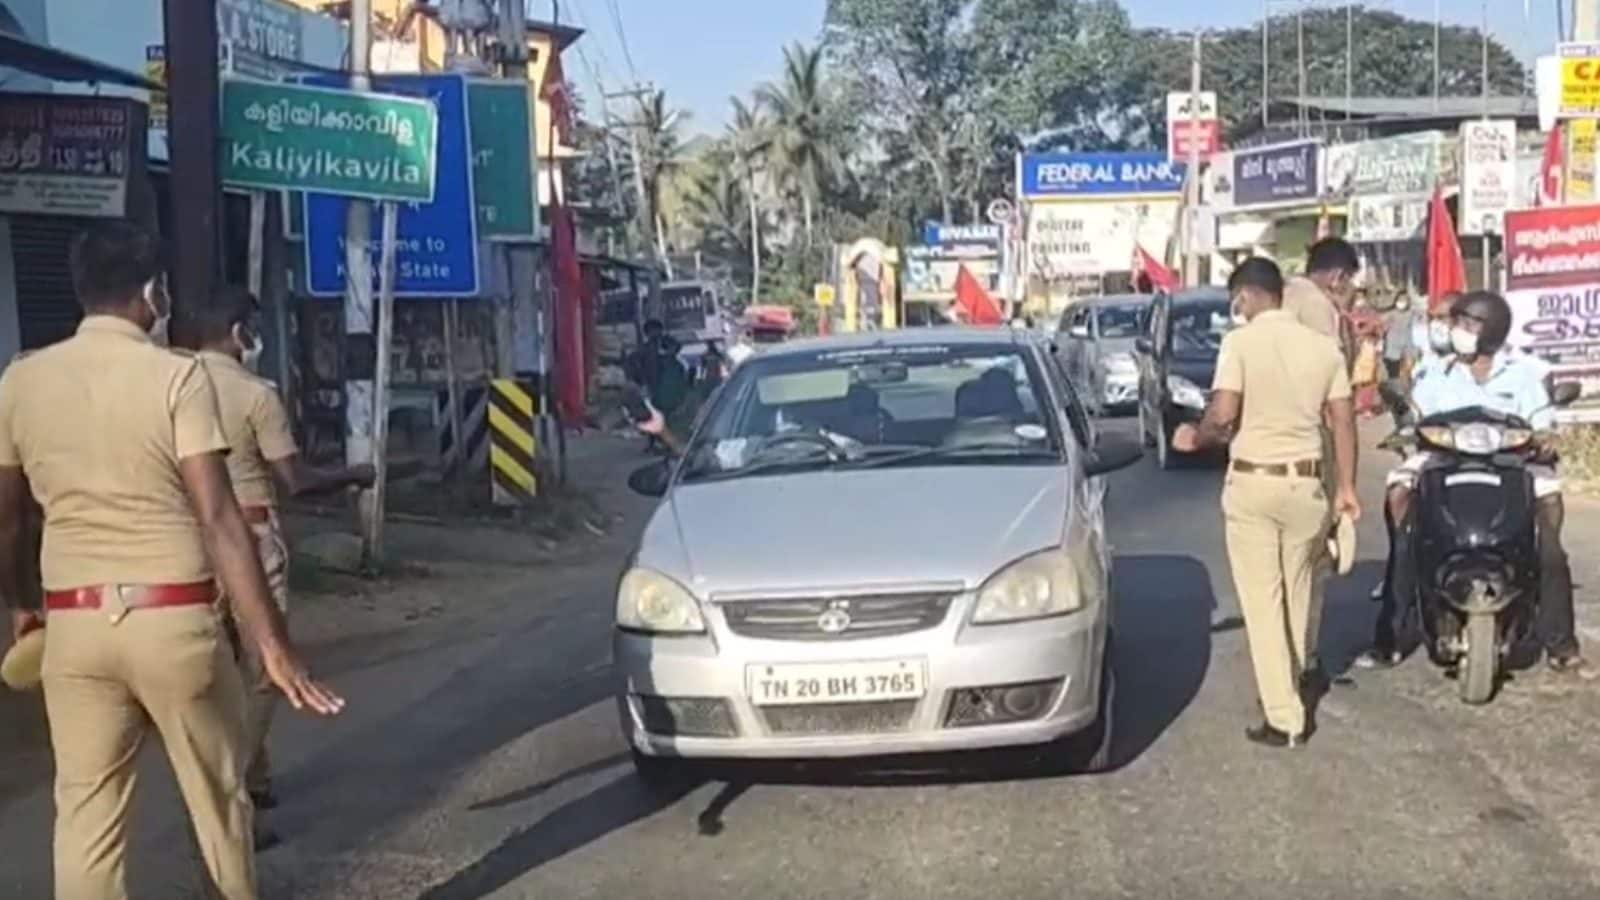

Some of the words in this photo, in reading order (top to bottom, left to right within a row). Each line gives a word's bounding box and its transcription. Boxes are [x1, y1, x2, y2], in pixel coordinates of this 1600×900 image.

[231, 141, 420, 184] Kaliyikavila
[1036, 162, 1116, 183] FEDERAL
[426, 236, 446, 252] to
[401, 262, 451, 278] State
[760, 680, 789, 698] TN
[796, 679, 821, 697] 20
[827, 677, 858, 696] BH
[864, 672, 916, 694] 3765
